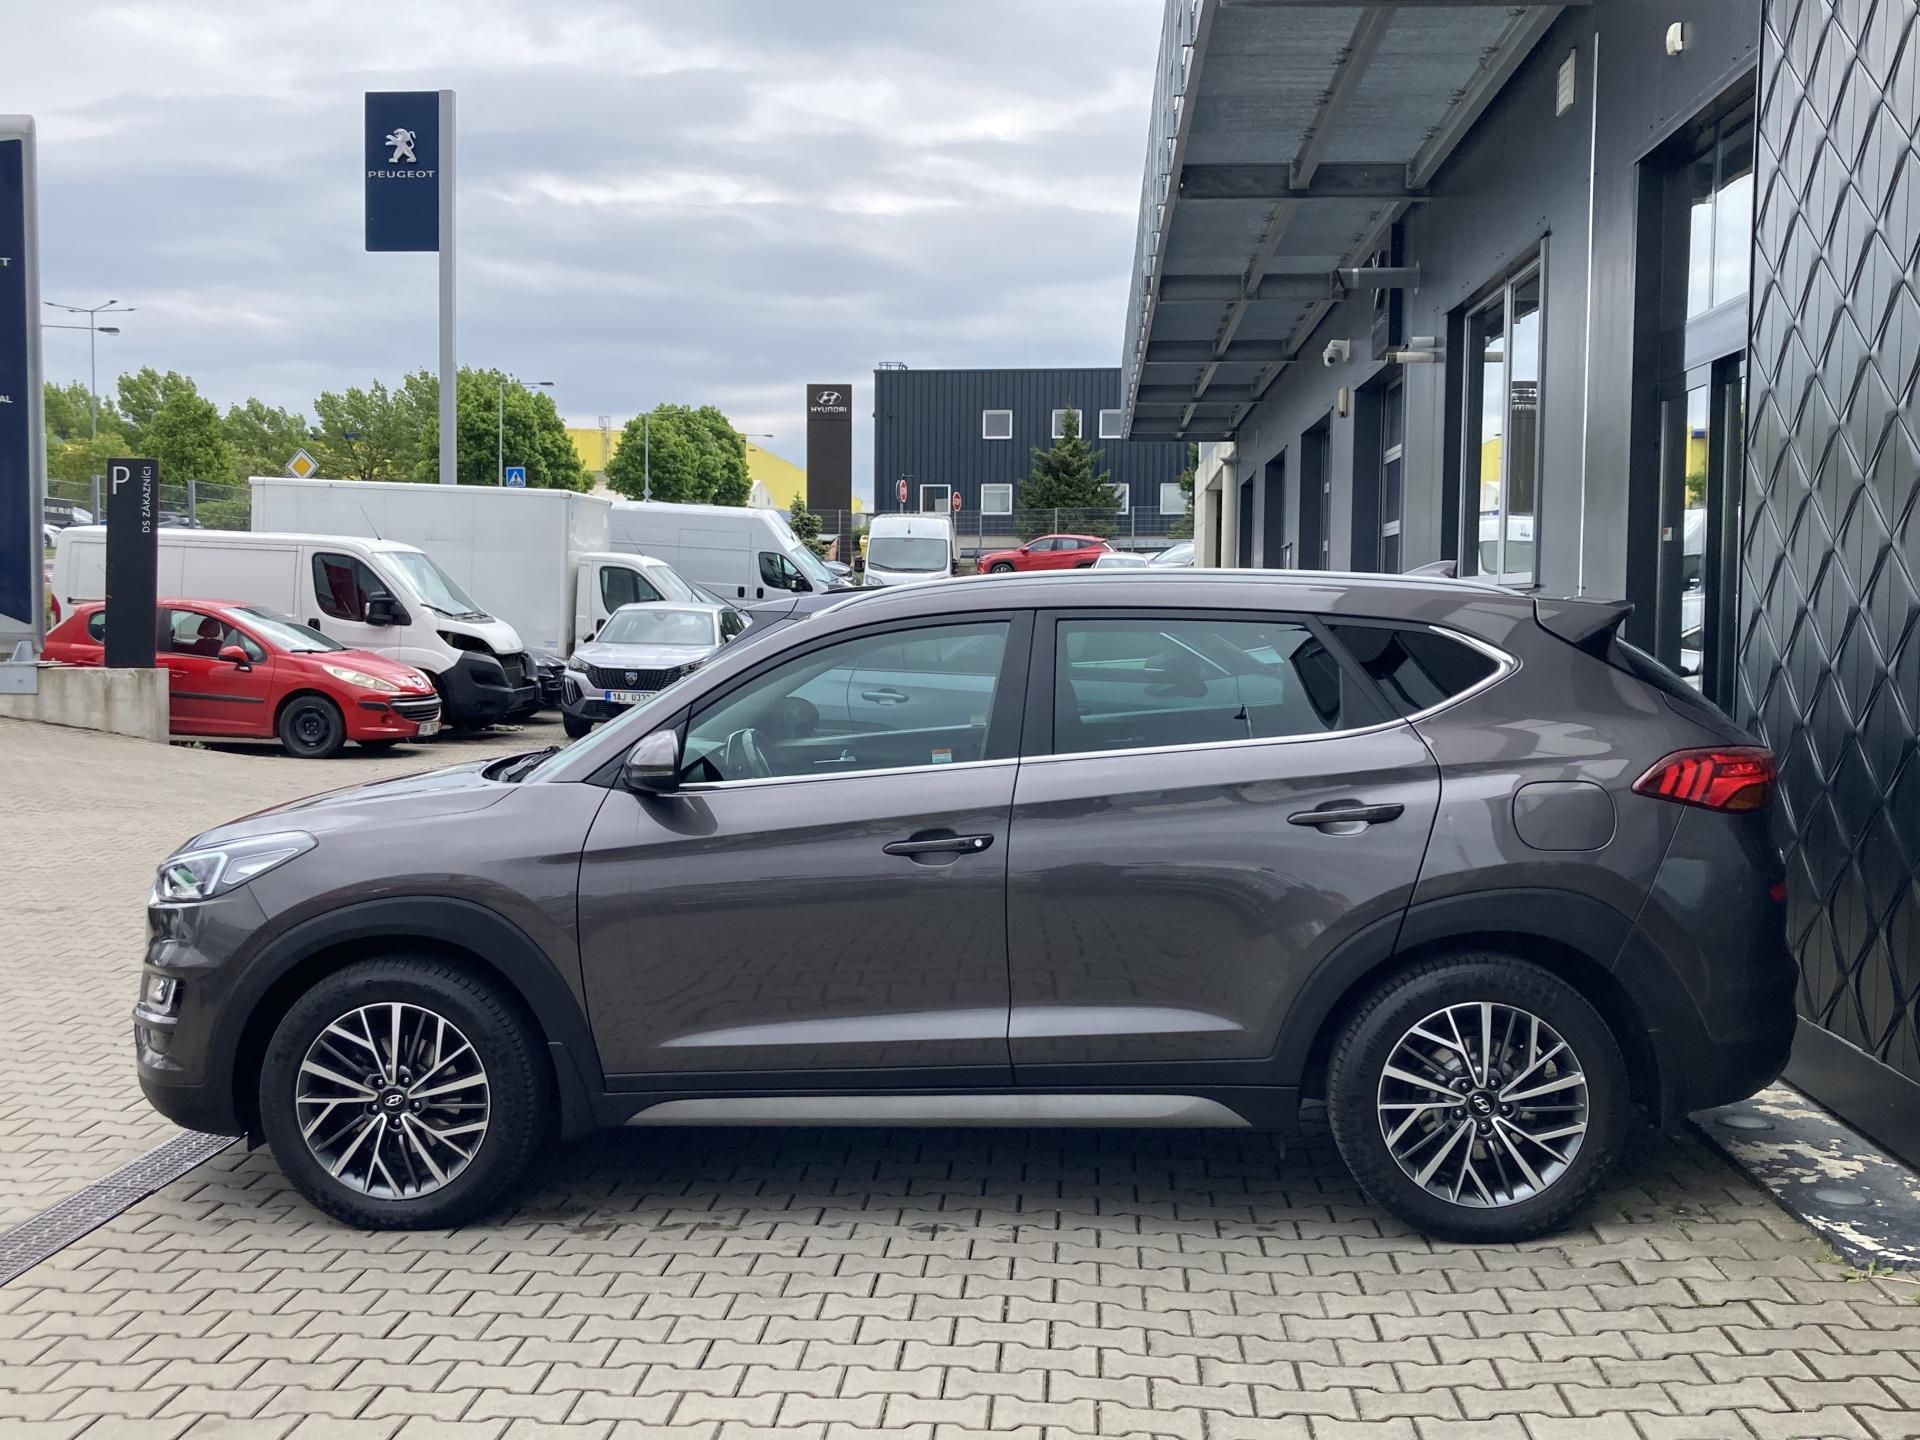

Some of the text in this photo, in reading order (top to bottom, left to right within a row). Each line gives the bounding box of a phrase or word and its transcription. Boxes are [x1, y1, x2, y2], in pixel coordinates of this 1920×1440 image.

[367, 170, 436, 178] PEUGEOT
[112, 465, 131, 495] P
[141, 466, 152, 533] DS ZÁKAZNÍCI
